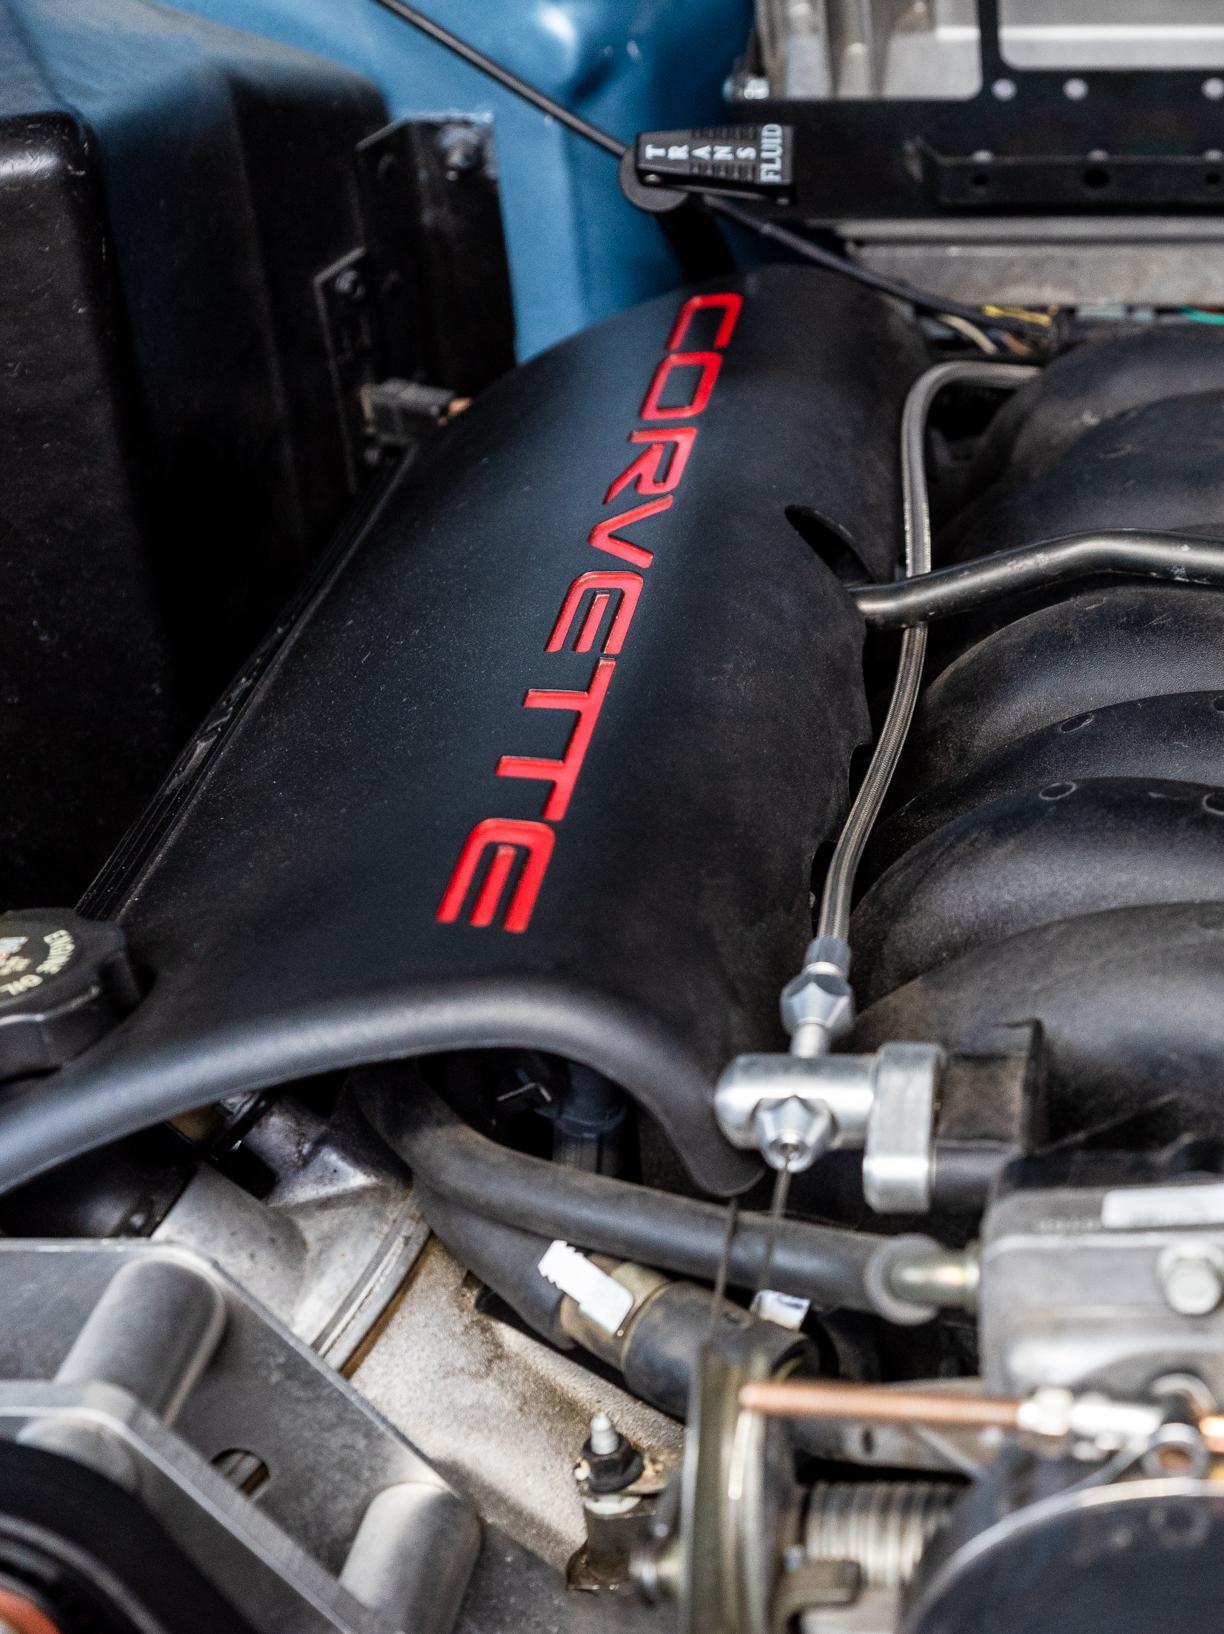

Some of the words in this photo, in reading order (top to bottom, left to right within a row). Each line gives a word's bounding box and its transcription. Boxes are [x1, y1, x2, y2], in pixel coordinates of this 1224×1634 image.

[645, 144, 757, 160] TRANS
[760, 123, 783, 182] FLUID
[436, 293, 743, 934] CORVETTE
